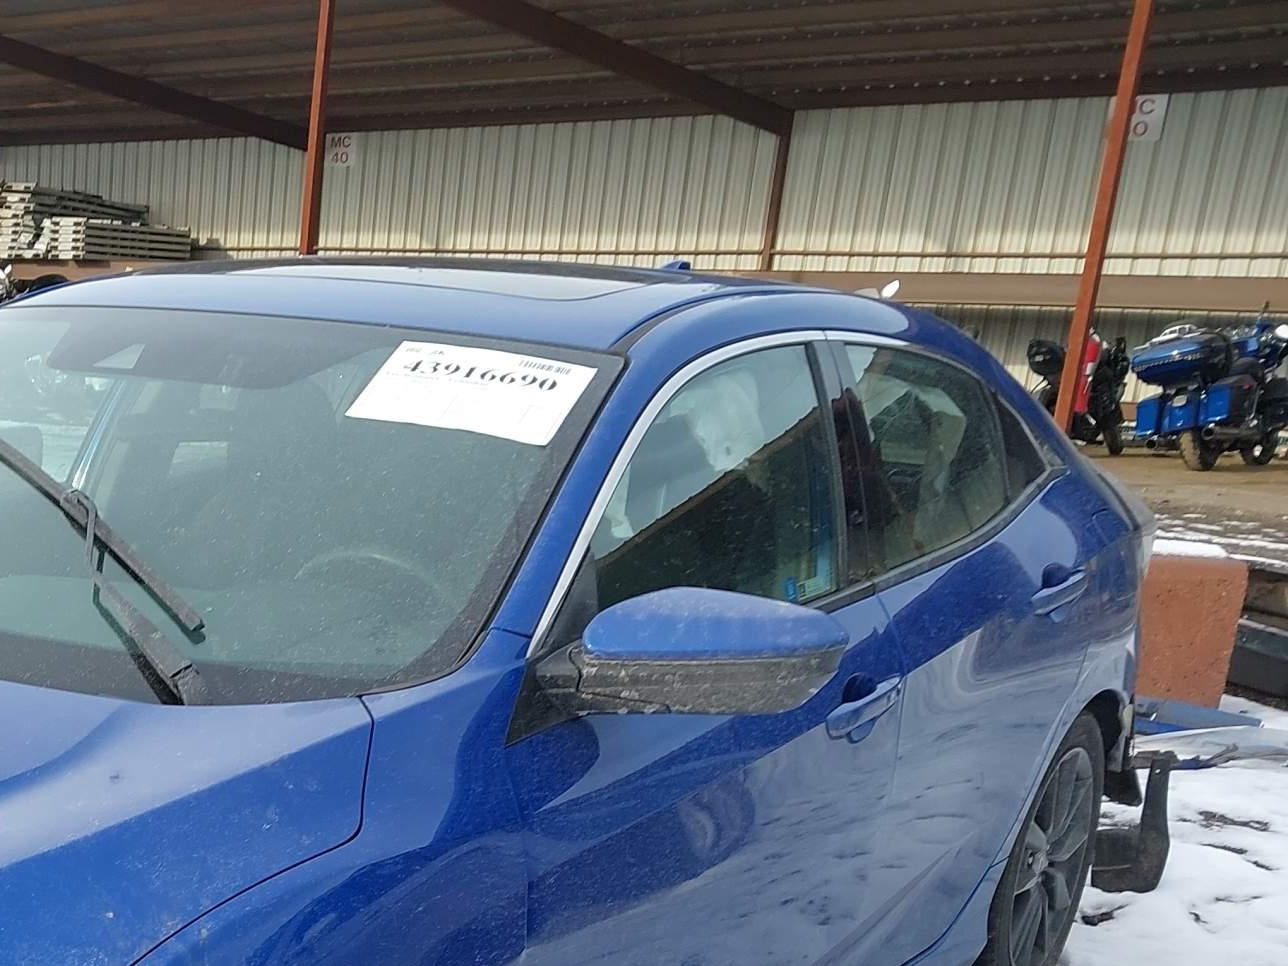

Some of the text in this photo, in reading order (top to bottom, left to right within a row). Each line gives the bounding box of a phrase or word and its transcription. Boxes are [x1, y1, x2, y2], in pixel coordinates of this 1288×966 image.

[330, 136, 352, 149] MC
[331, 151, 349, 164] 40
[403, 358, 558, 393] 43916690
